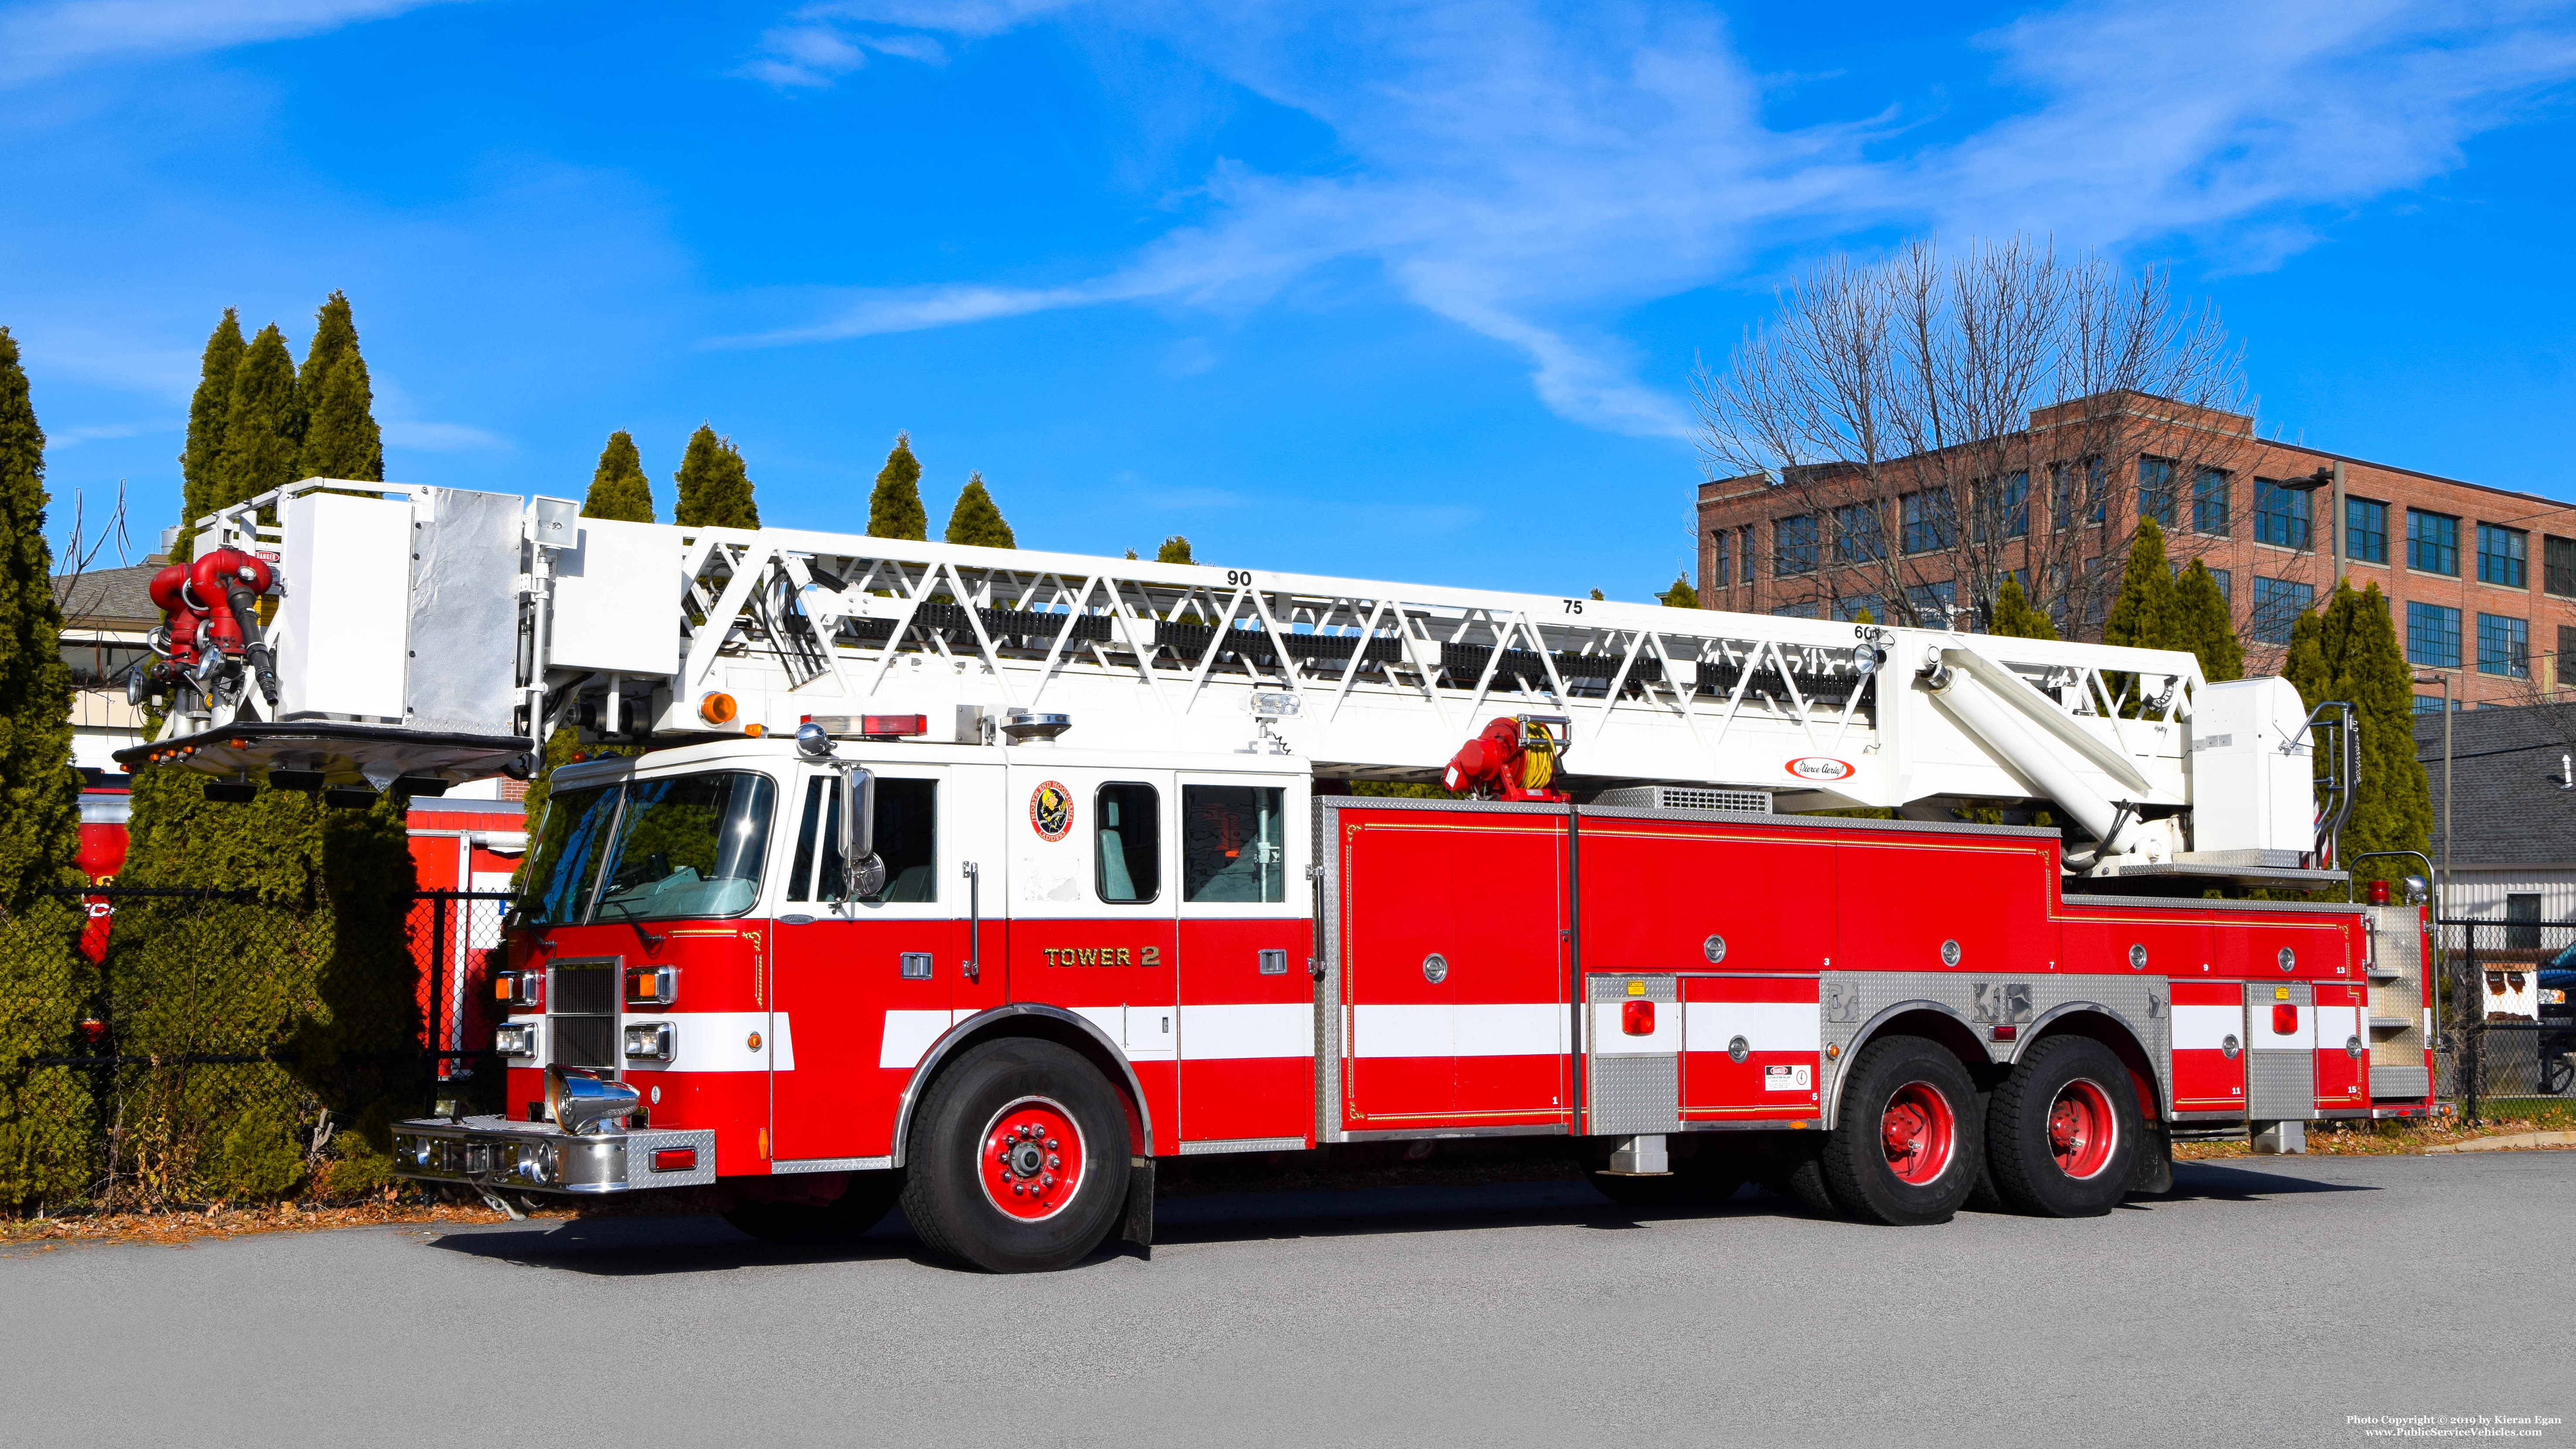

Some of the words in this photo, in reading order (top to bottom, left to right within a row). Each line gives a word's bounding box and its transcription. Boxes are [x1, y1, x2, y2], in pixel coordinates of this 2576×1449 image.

[1228, 570, 1252, 586] 90
[1564, 599, 1582, 615] 75
[1855, 625, 1872, 640] 60
[1799, 760, 1820, 774] Pierce
[1822, 763, 1844, 777] Aerial
[1031, 792, 1040, 820] NORTH
[1039, 781, 1051, 792] END
[1052, 781, 1073, 820] HOOLIGANS
[1038, 830, 1066, 841] LADDERS
[1043, 948, 1131, 967] TOWER
[1140, 946, 1160, 967] 2
[1824, 957, 1830, 966] 3
[1552, 1096, 1558, 1105] 1
[1812, 1092, 1818, 1101] 5
